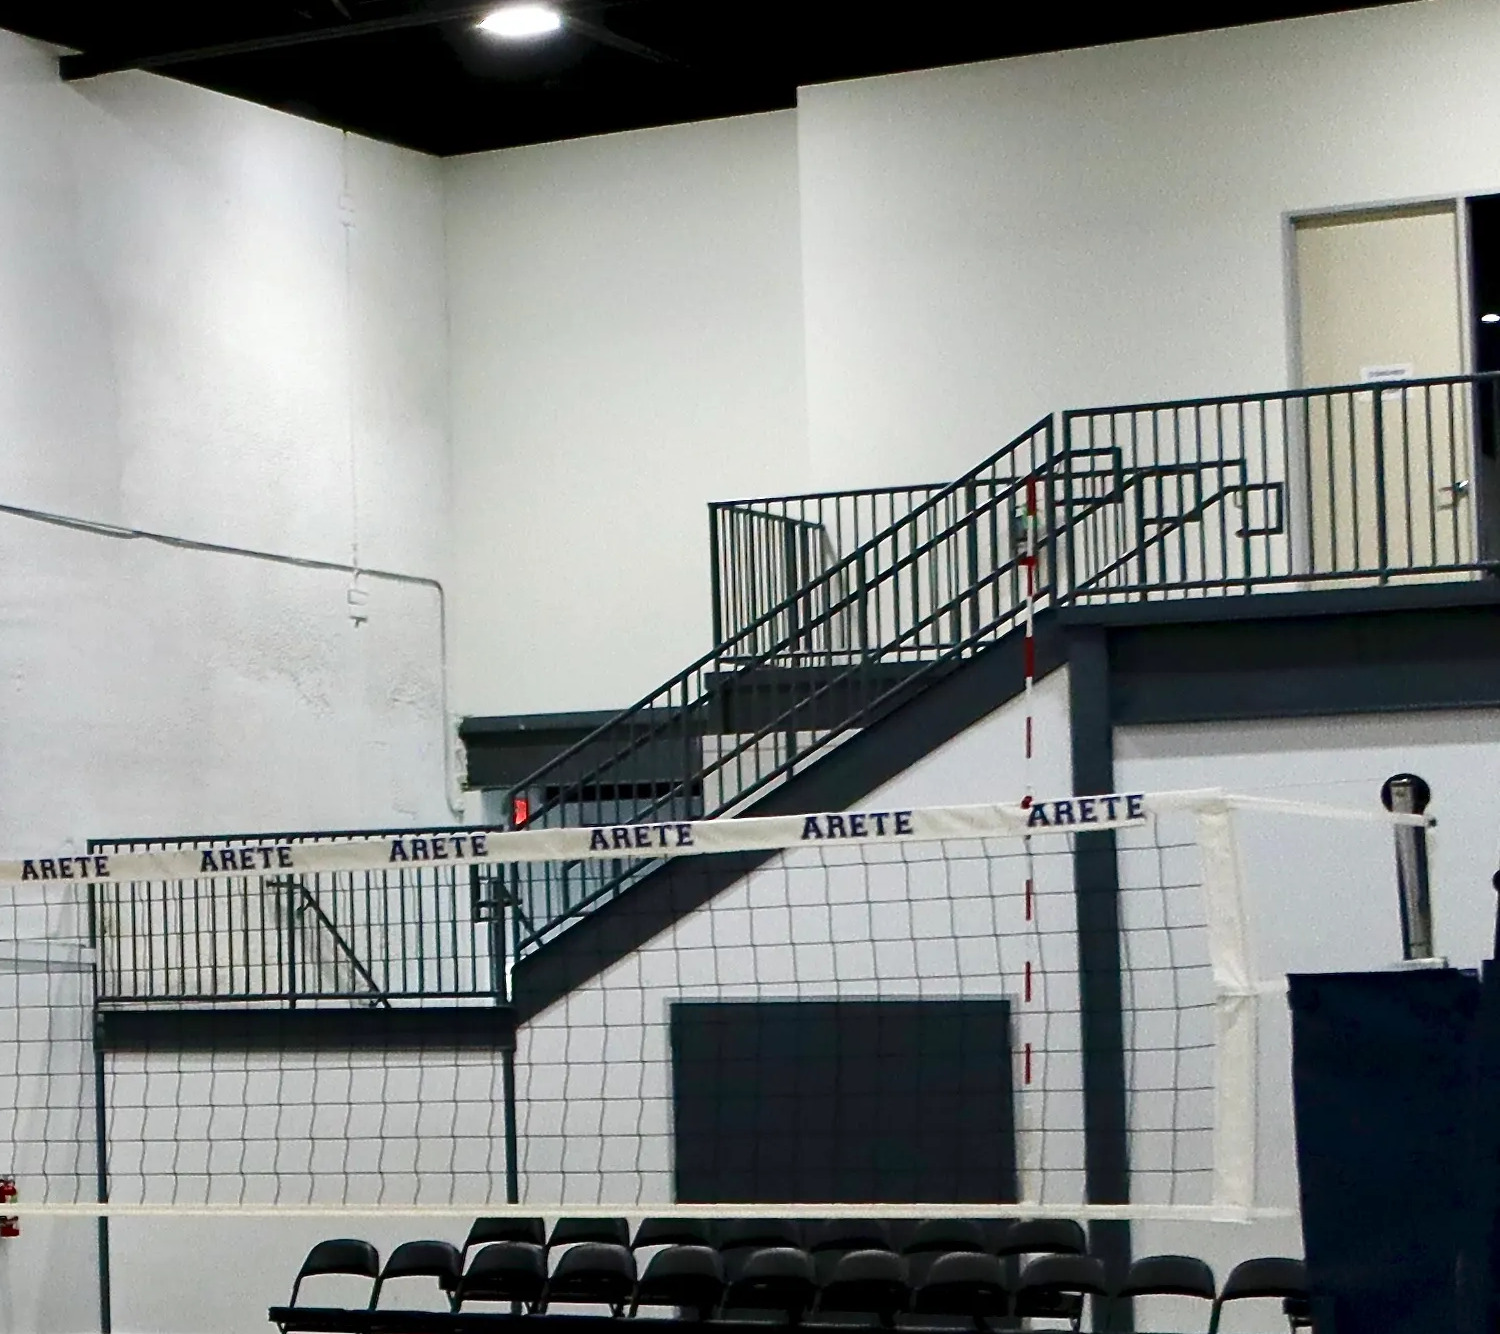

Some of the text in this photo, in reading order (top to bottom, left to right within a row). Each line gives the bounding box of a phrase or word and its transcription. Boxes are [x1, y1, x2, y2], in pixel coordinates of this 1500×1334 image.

[21, 855, 111, 881] ARETE
[200, 846, 294, 873] ARETE
[388, 834, 488, 862] ARETE
[589, 822, 694, 852] ARETE
[800, 810, 915, 841] ARETE
[1027, 793, 1146, 827] ARETE
